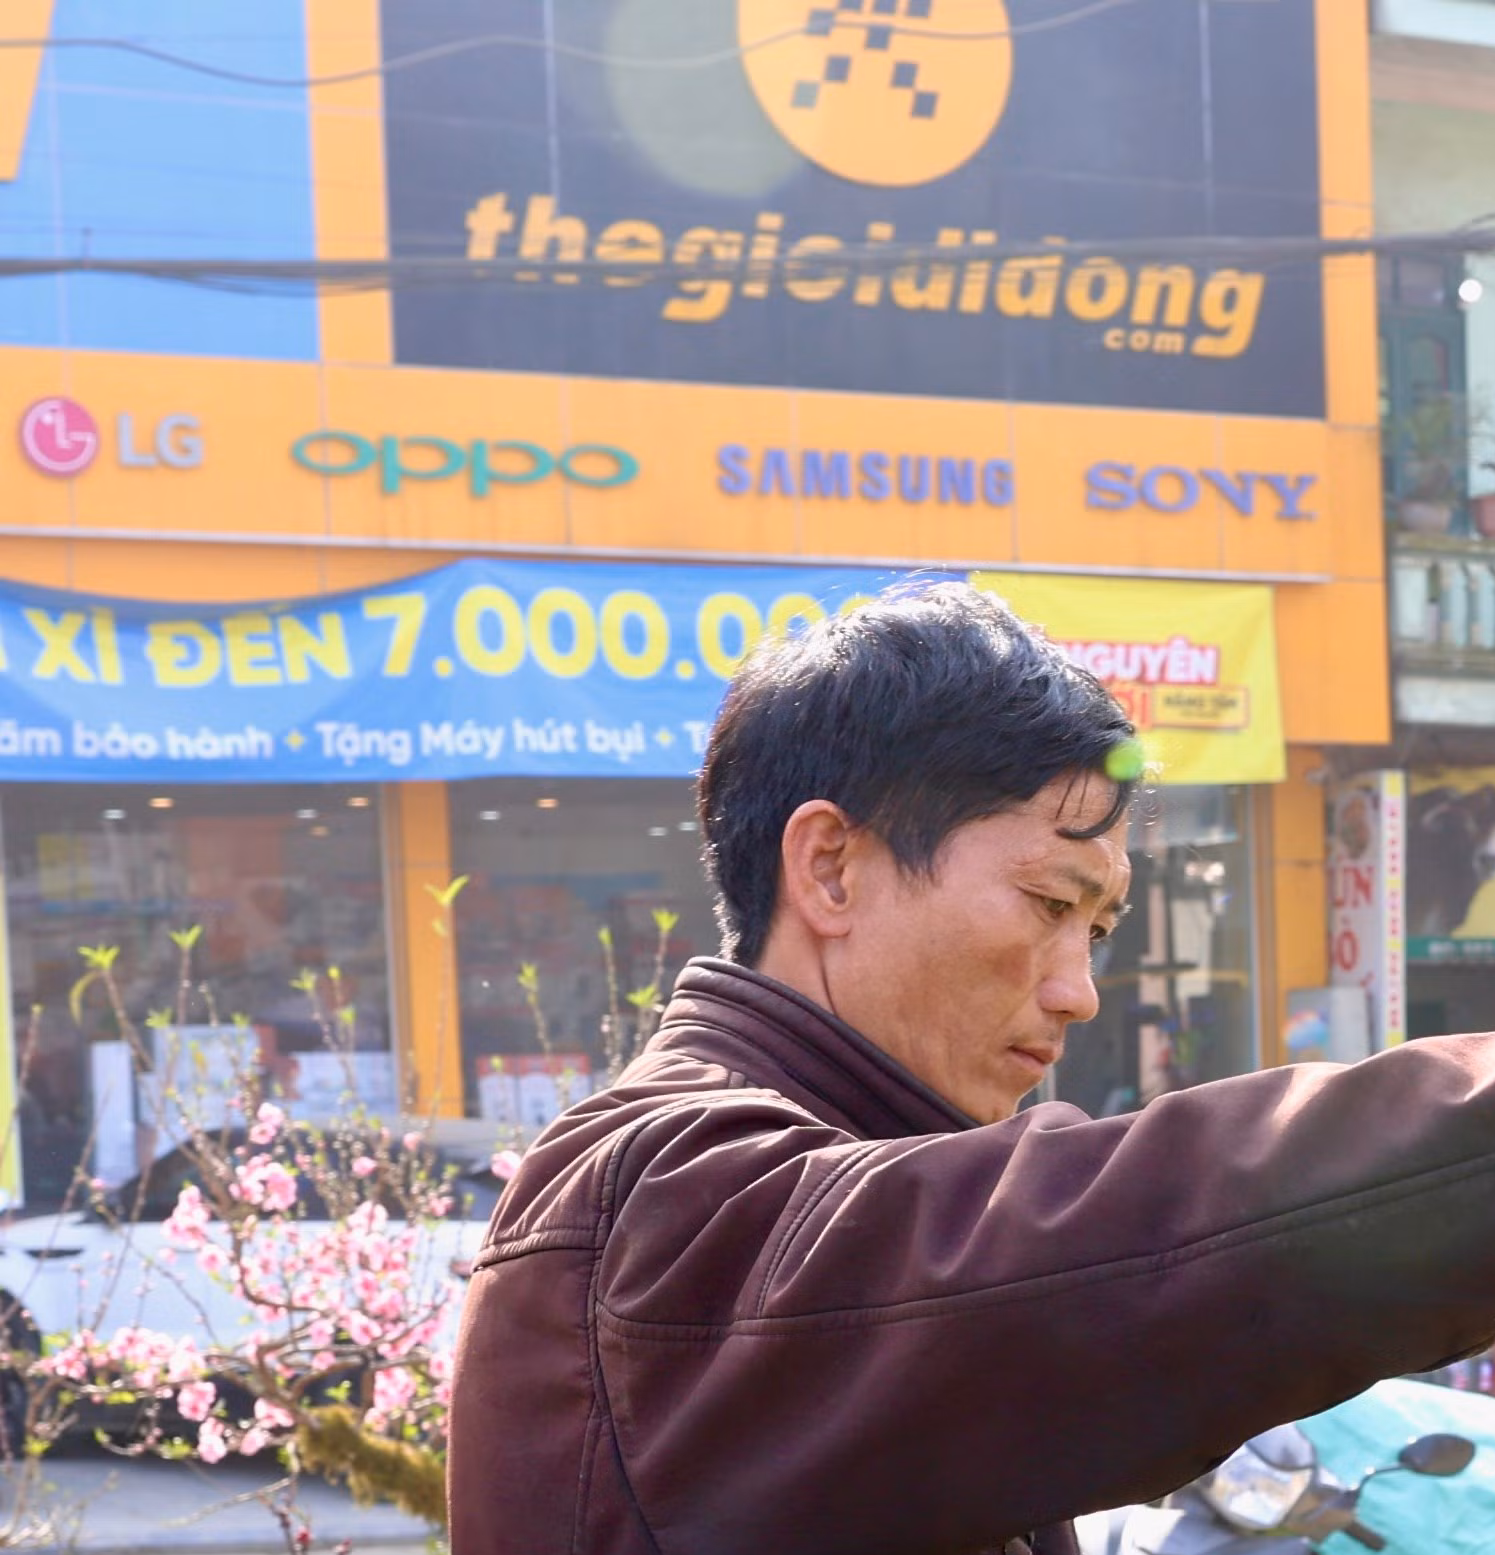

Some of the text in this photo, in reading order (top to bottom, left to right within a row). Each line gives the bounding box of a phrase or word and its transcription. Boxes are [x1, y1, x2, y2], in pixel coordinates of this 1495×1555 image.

[116, 413, 203, 468] LG
[716, 443, 1013, 507] SAMSUNG
[1084, 461, 1318, 522] SONY
[363, 584, 882, 680] 7.000.0
[315, 722, 411, 766] Tặng
[422, 719, 503, 759] Máy
[515, 718, 576, 754] hút
